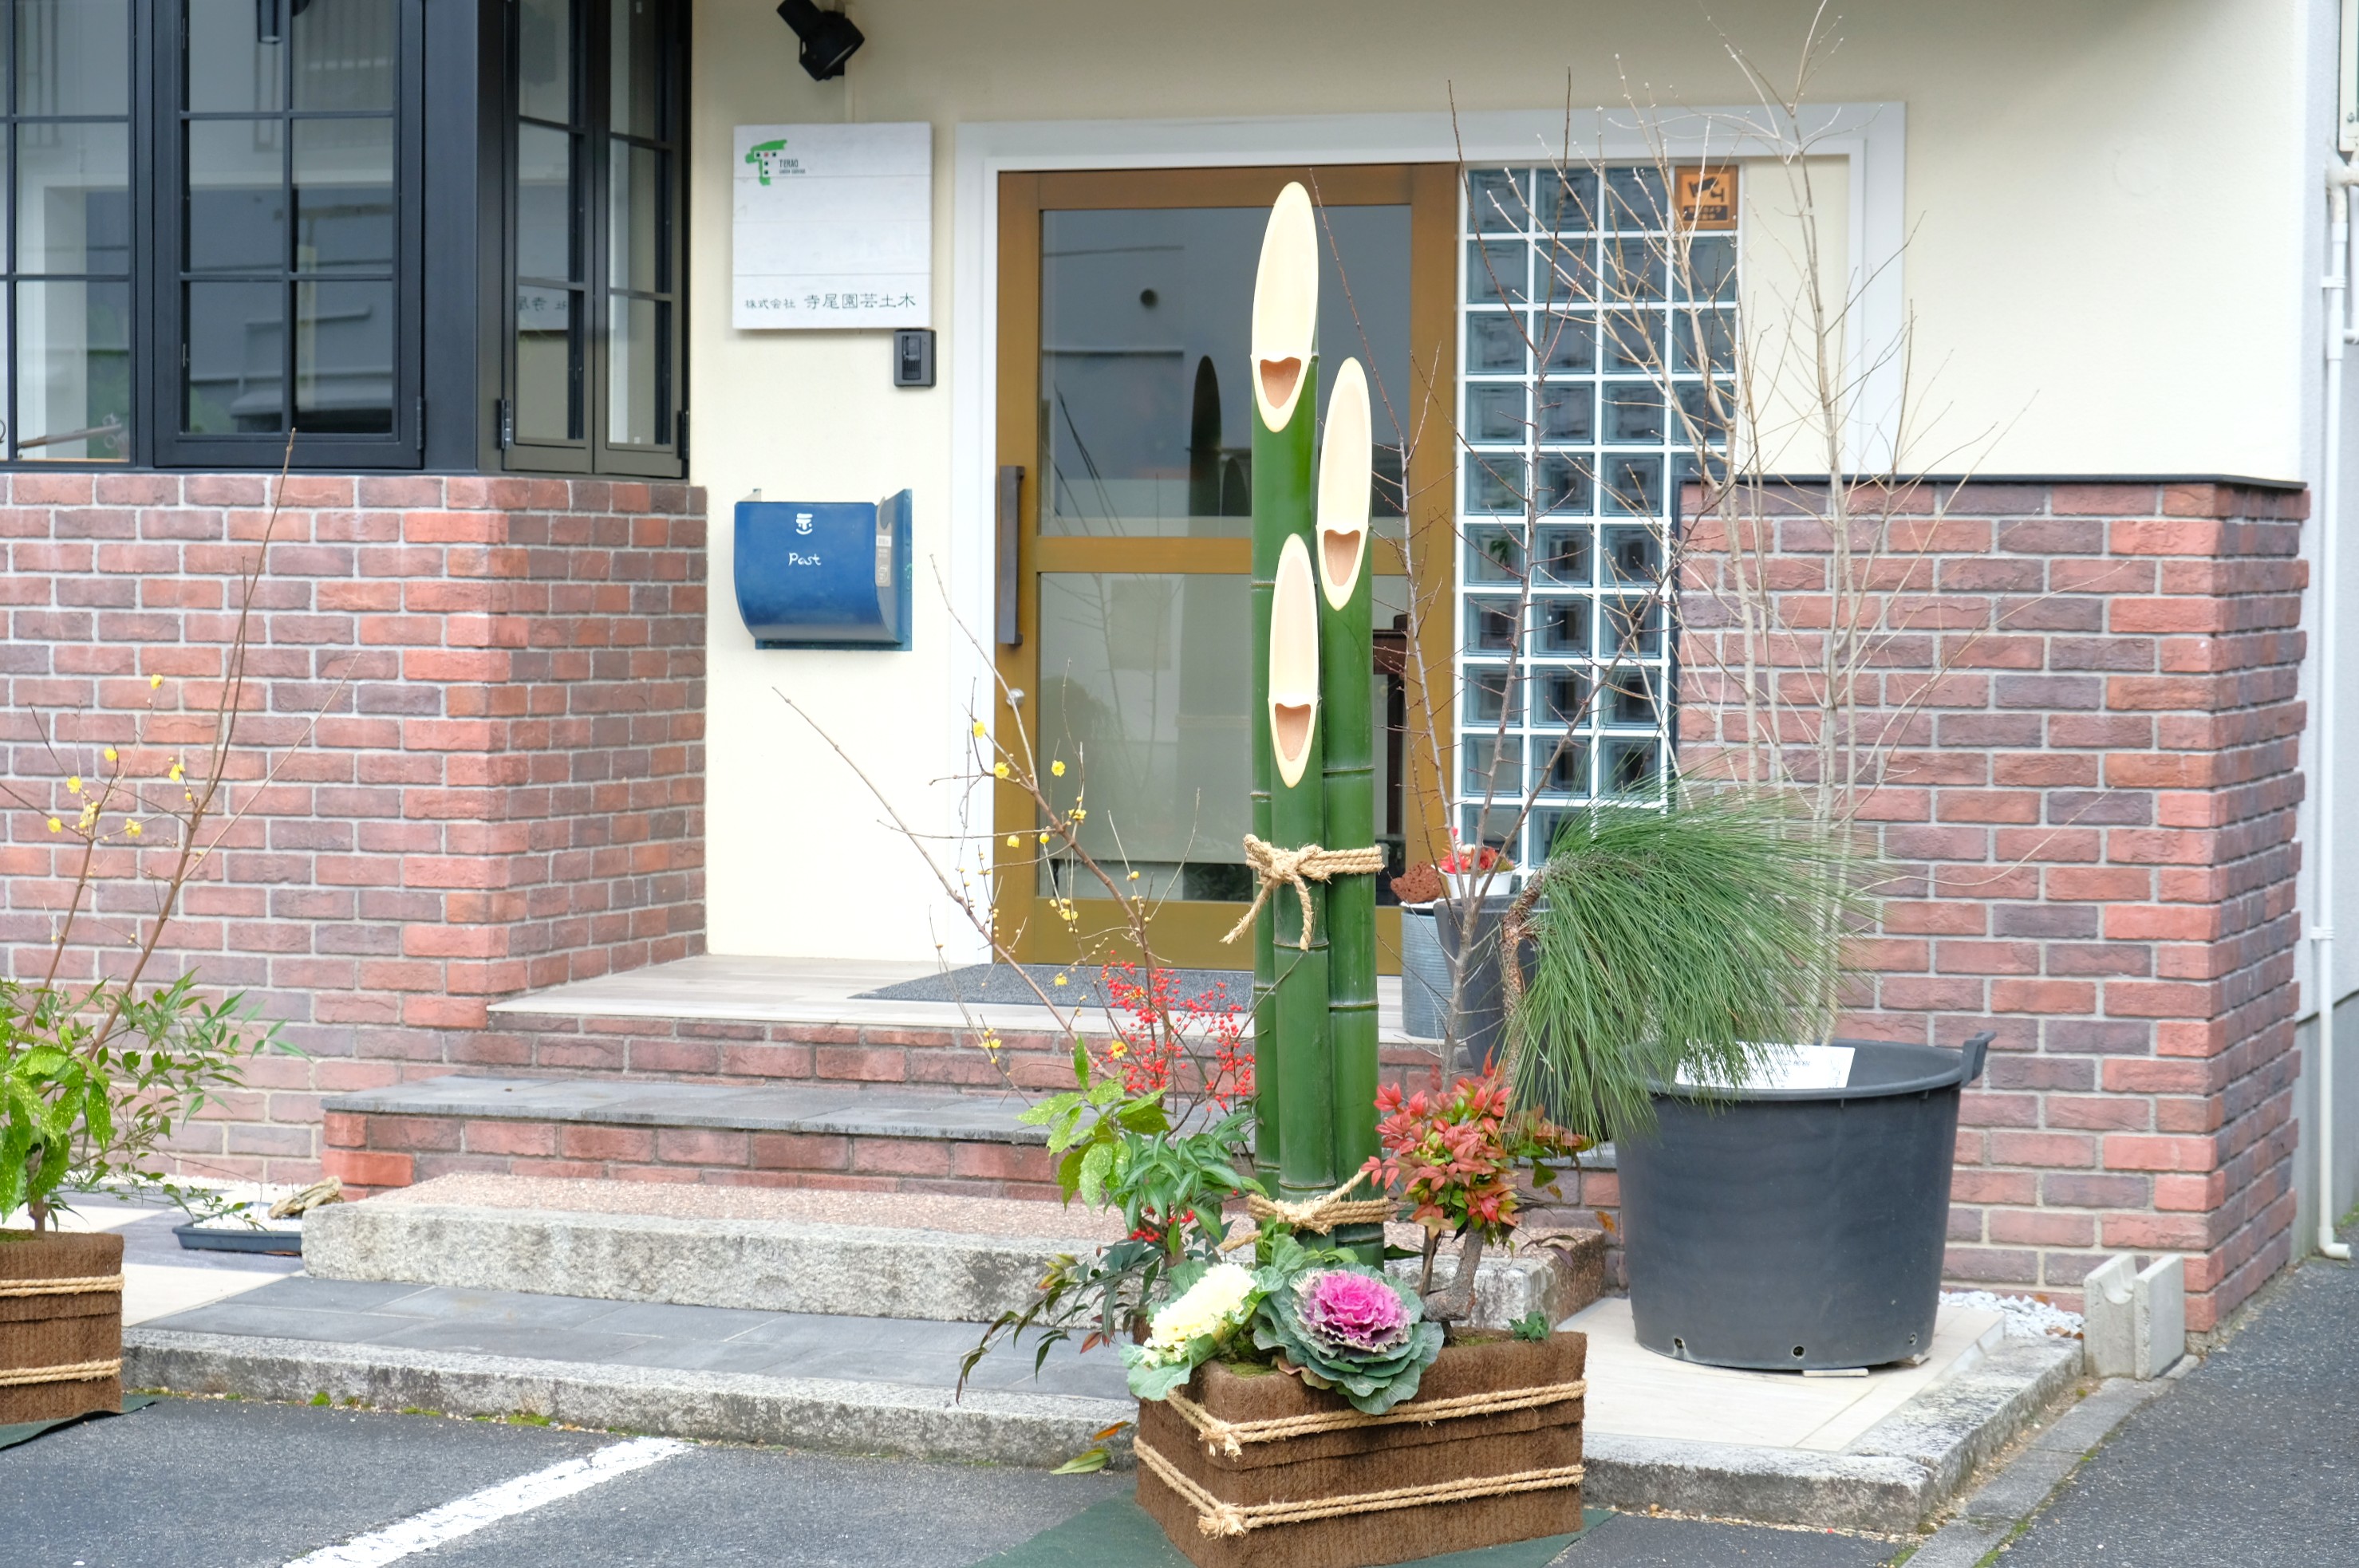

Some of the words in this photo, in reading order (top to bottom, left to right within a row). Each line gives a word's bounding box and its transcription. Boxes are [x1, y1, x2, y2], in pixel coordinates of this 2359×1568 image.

[779, 159, 799, 168] TERAO
[744, 297, 796, 310] 株式会社
[804, 292, 917, 310] 寺尾園芸土木
[788, 552, 822, 566] Post
